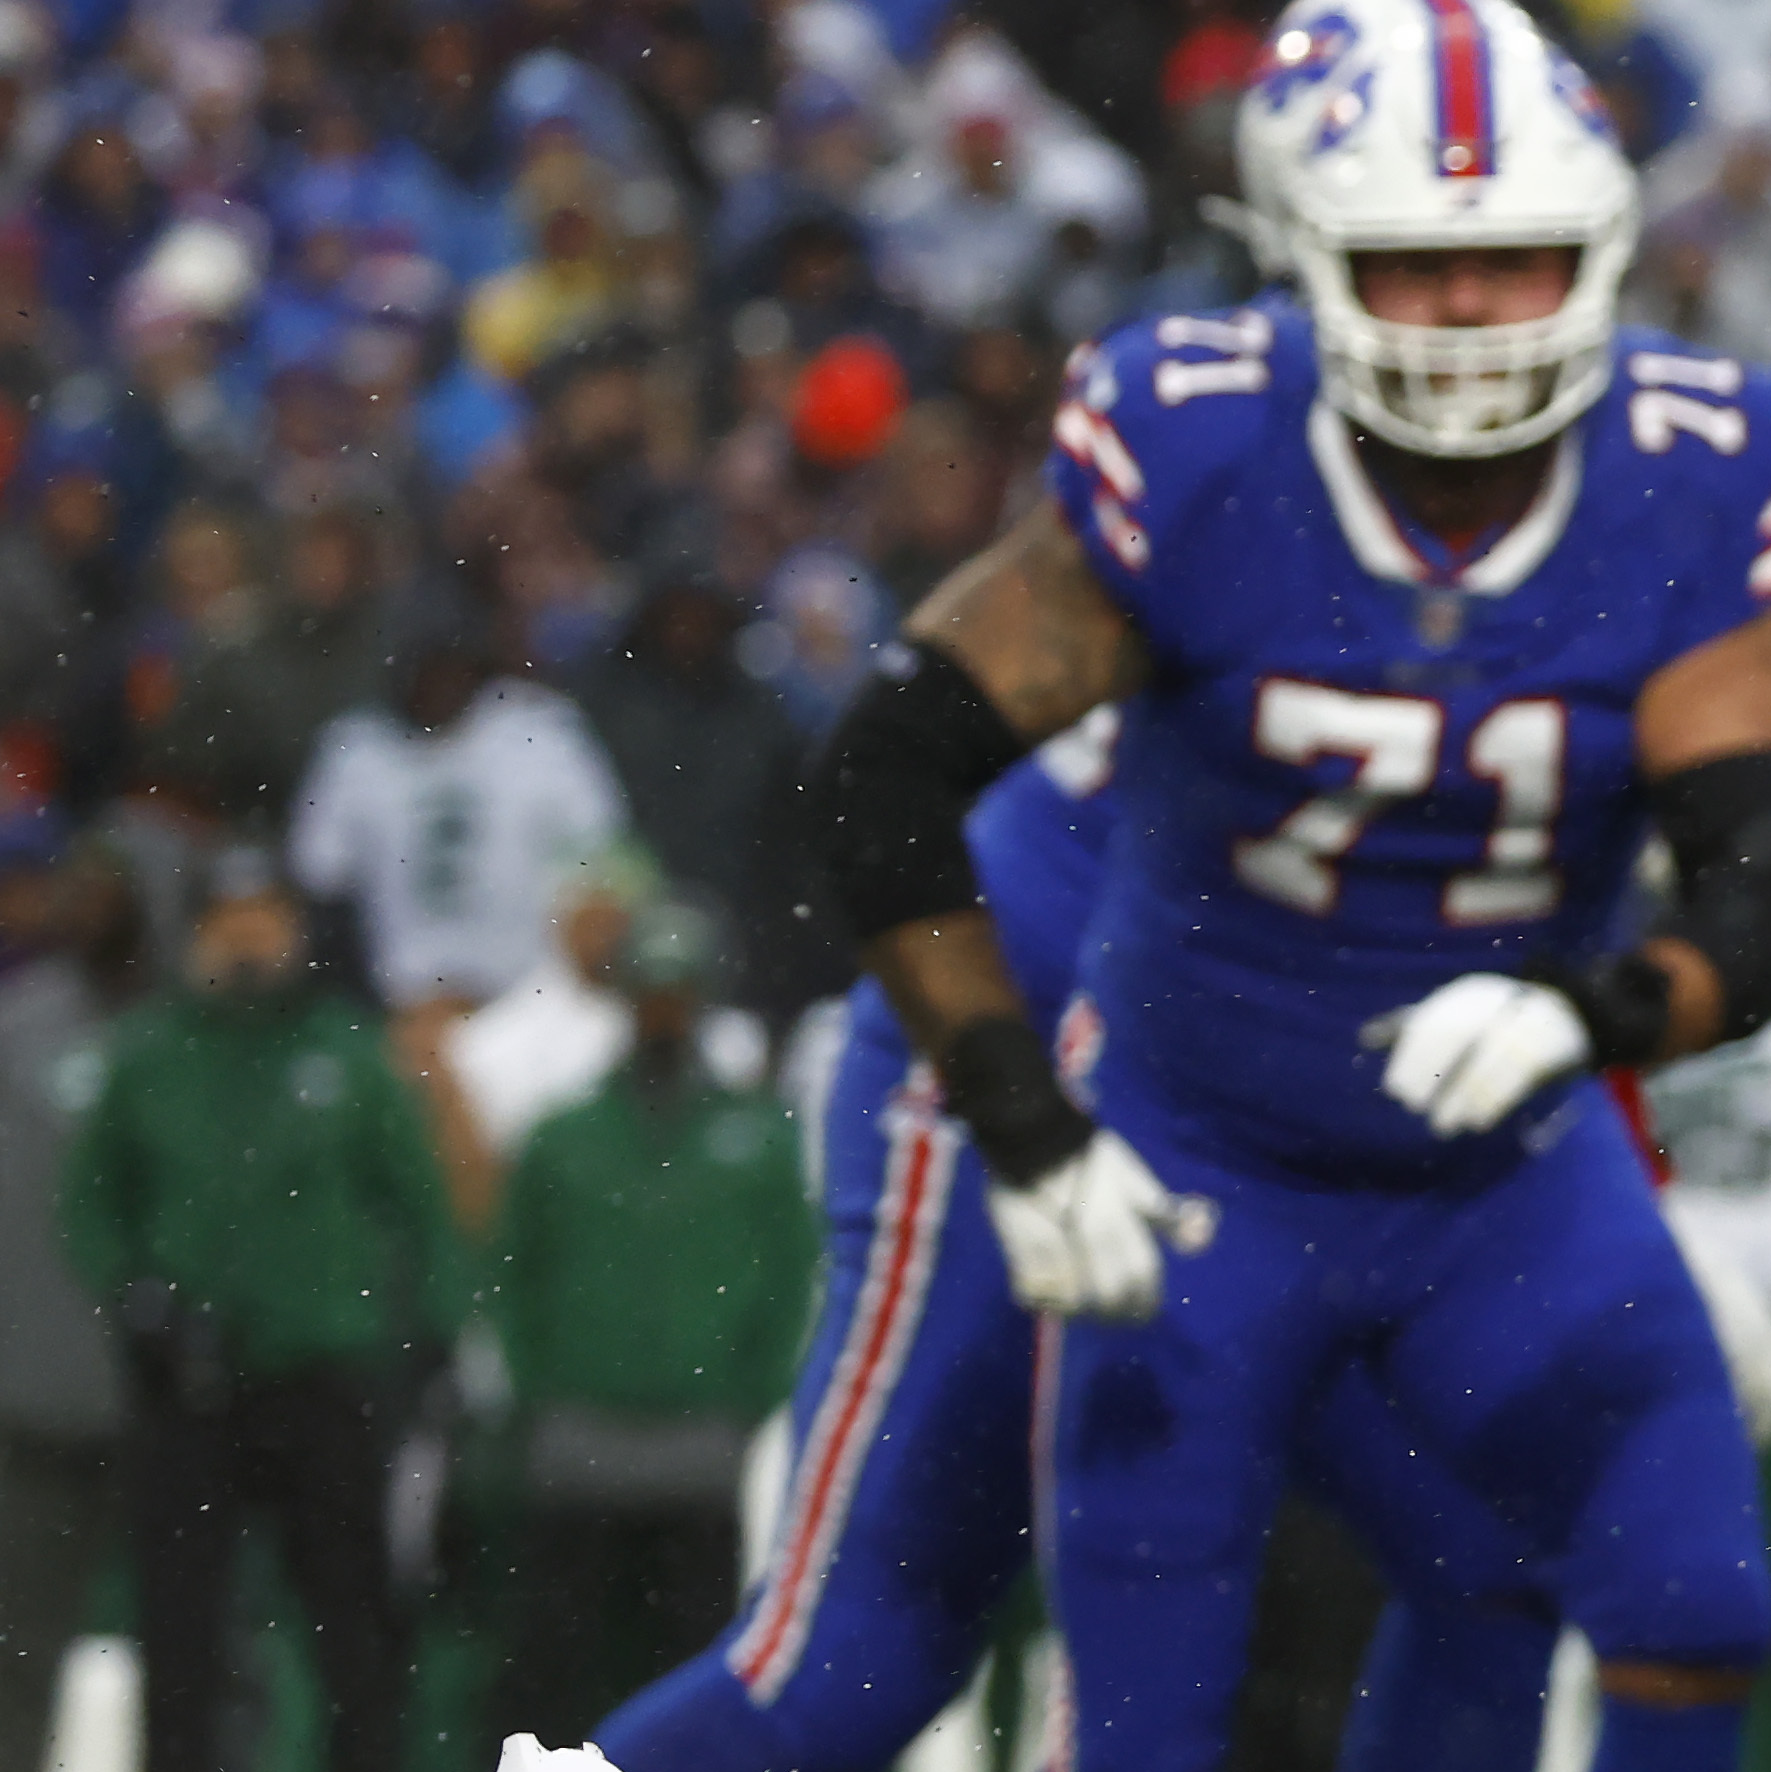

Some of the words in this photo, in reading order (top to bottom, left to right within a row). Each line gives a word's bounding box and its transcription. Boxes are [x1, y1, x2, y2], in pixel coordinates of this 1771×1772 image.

[1153, 308, 1275, 408] 71
[1628, 351, 1750, 456] 71
[1232, 676, 1565, 926] 71
